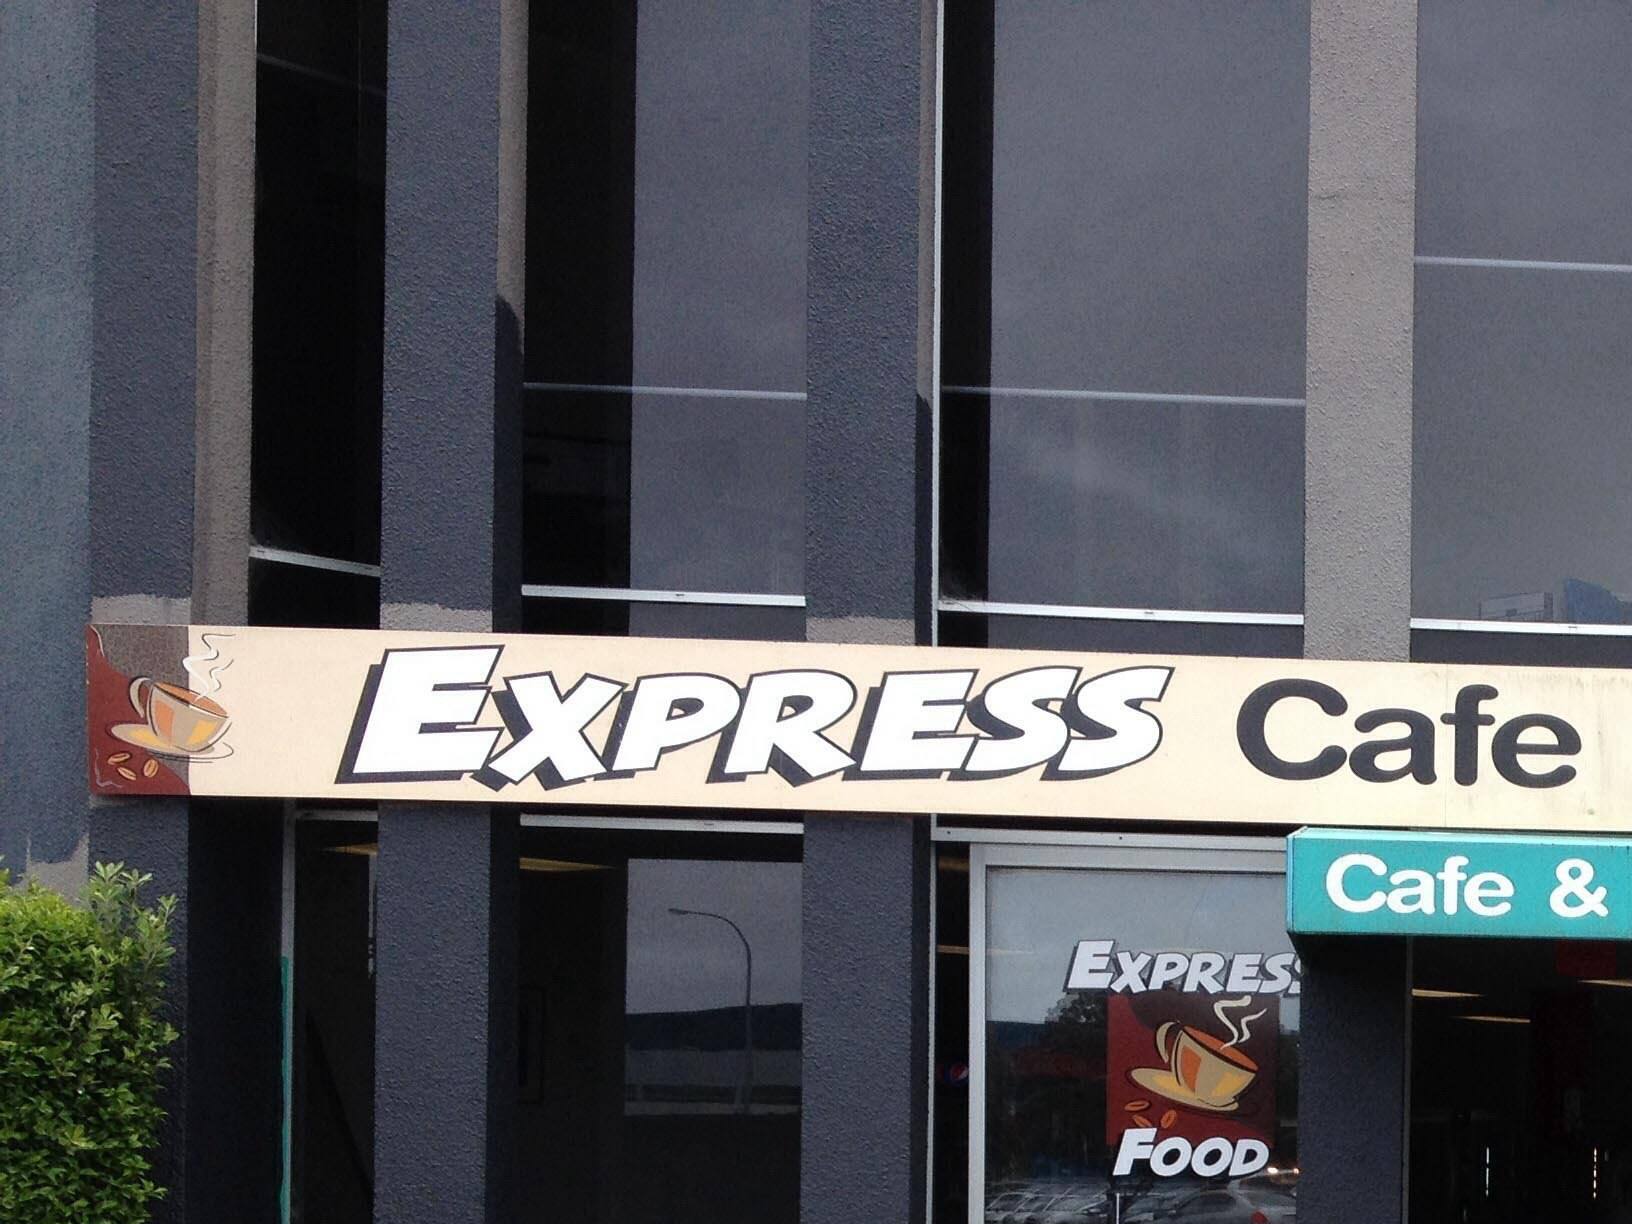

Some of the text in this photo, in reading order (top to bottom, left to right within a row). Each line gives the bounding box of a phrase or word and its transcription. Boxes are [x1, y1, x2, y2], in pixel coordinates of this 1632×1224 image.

[335, 644, 1174, 791] EXPRESS
[1235, 678, 1582, 787] Cafe
[1325, 853, 1514, 916] Cafe
[1548, 857, 1608, 918] &
[1065, 939, 1301, 995] EXPRES
[1112, 1127, 1270, 1178] FOOD
